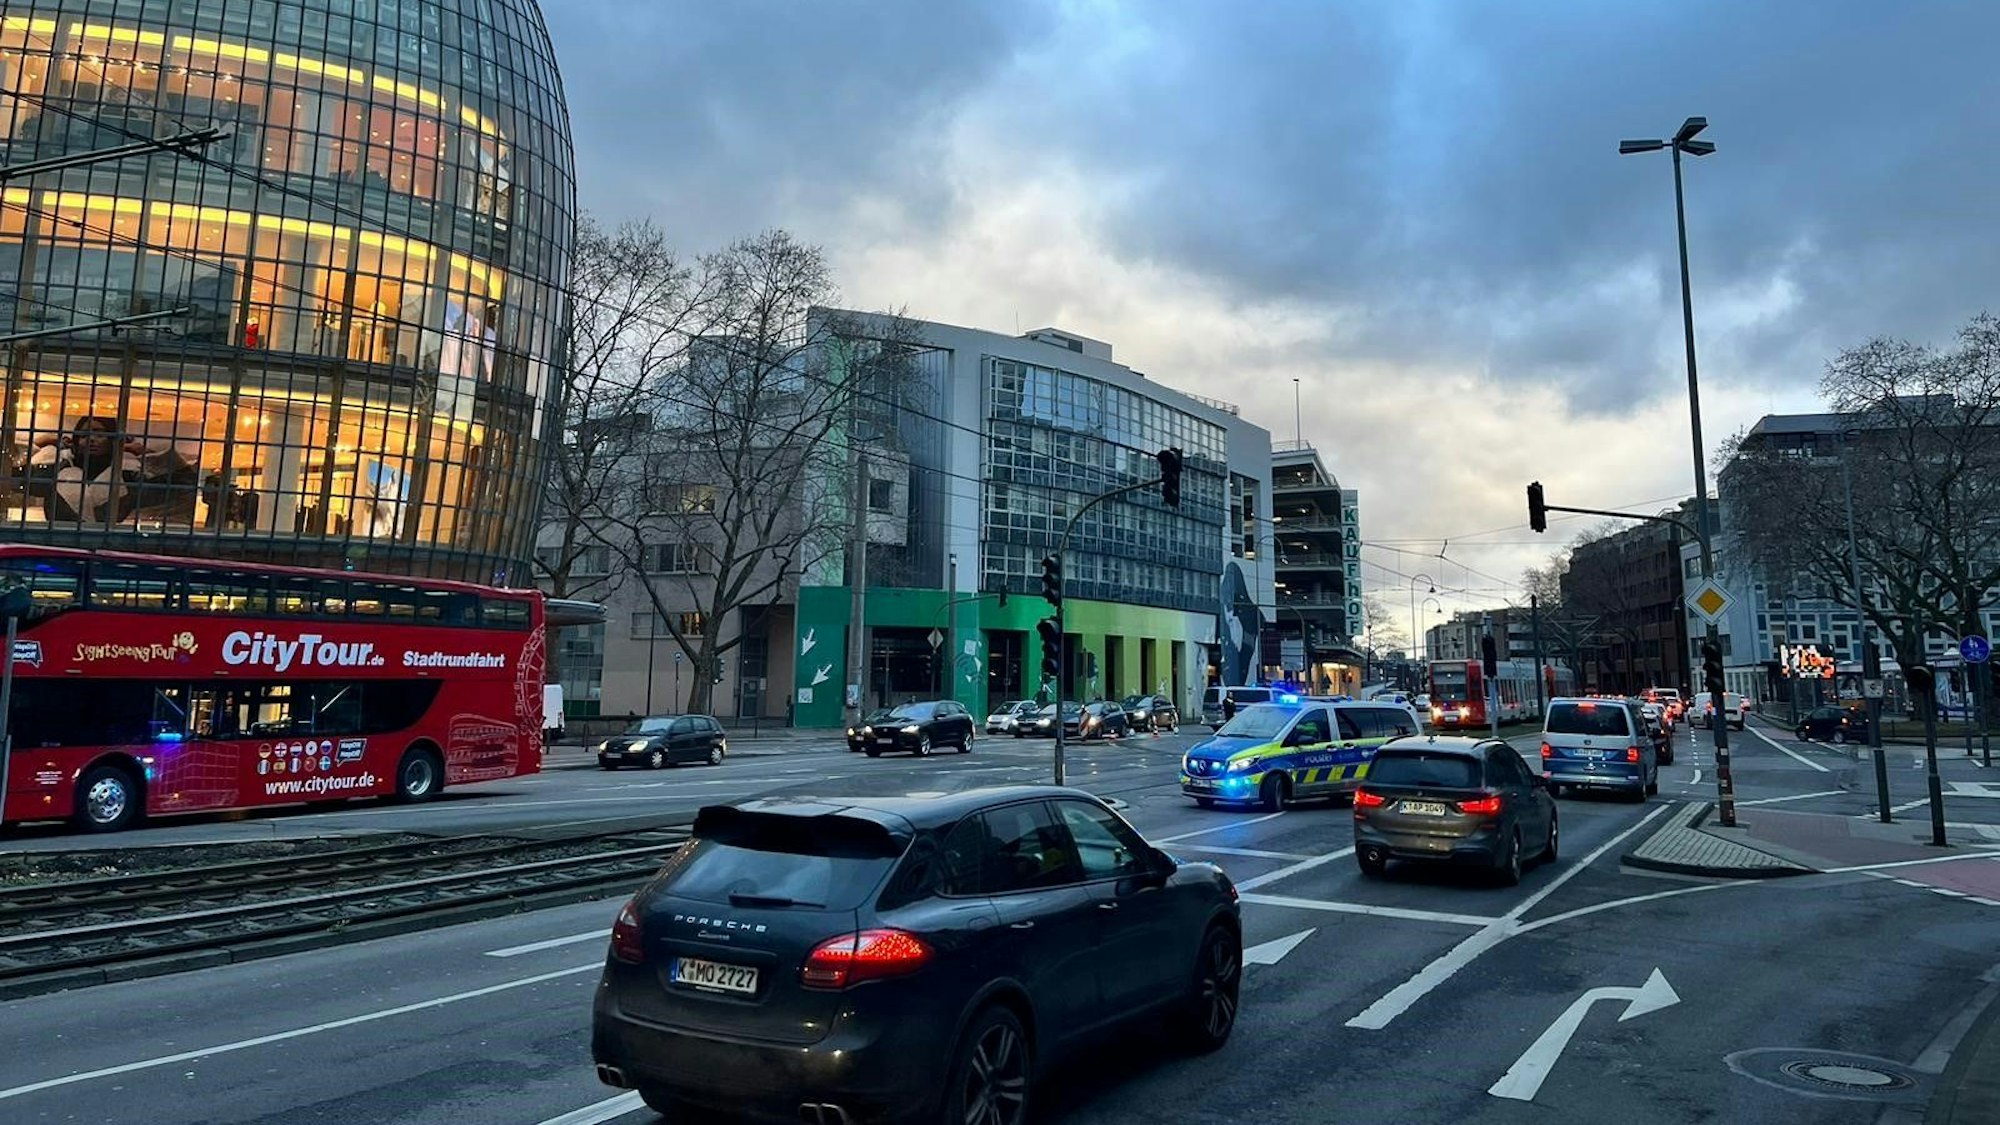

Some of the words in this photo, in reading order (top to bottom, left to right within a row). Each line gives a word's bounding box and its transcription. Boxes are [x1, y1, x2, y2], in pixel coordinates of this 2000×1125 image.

[221, 631, 385, 672] CityTour.de
[402, 650, 505, 668] Stadtrundfahrt
[265, 771, 375, 795] www.citytour.de
[674, 914, 767, 932] PORSCHE
[718, 966, 756, 988] 2727
